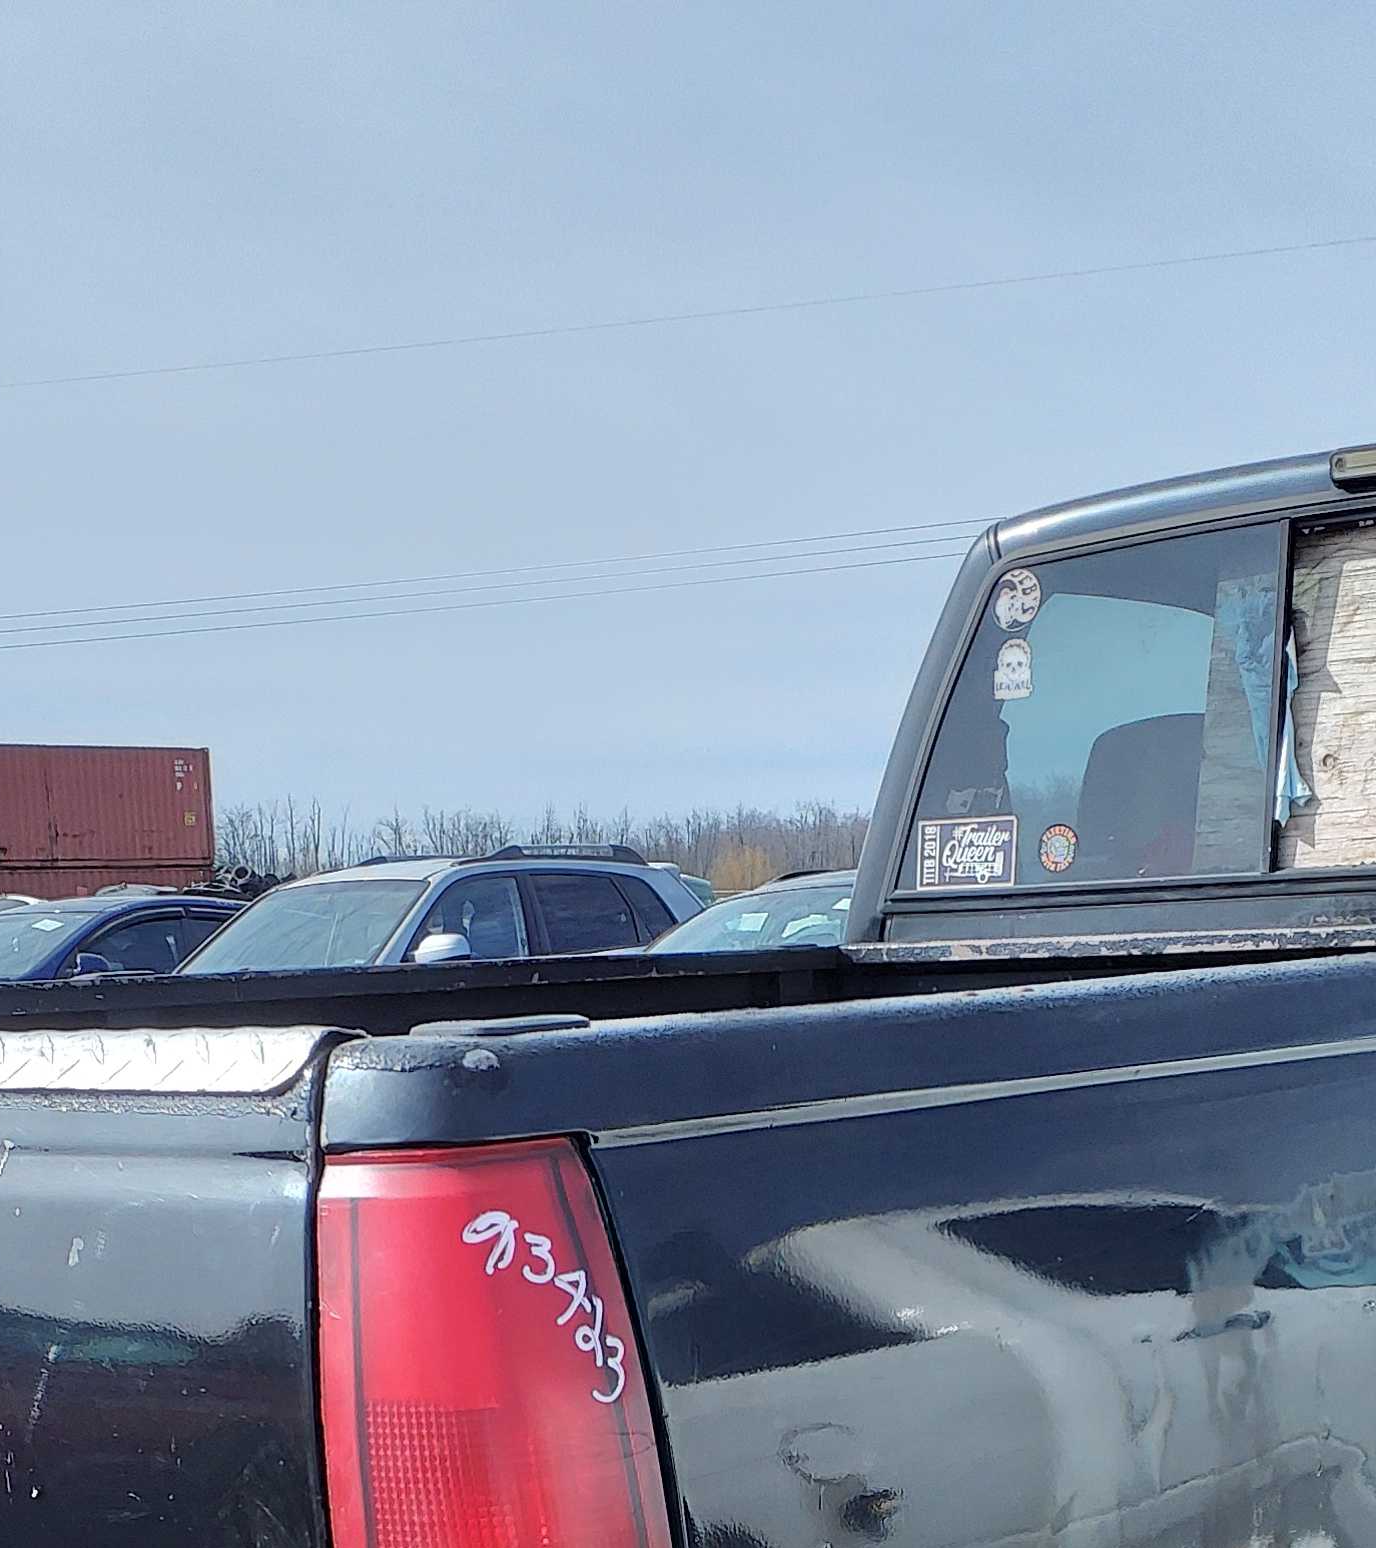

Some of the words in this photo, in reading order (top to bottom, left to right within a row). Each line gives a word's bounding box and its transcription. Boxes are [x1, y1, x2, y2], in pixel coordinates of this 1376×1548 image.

[923, 826, 937, 857] 2018
[951, 823, 1011, 847] #Trailer
[942, 840, 996, 868] Queen
